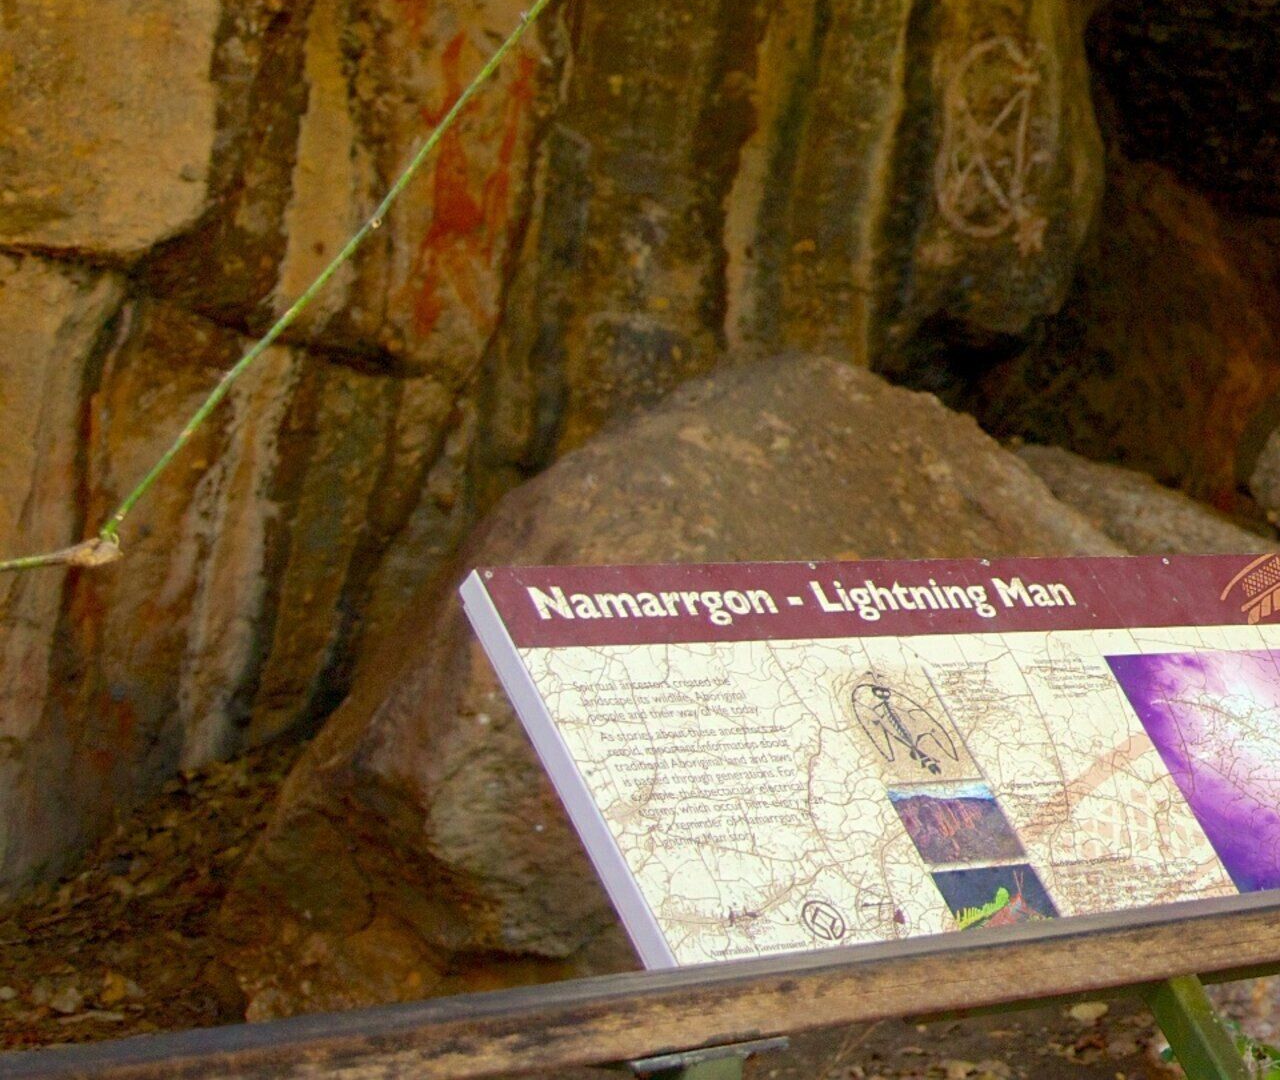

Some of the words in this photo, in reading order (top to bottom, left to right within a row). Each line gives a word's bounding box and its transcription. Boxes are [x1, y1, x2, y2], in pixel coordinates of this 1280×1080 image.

[526, 585, 778, 626] Namarrgon
[809, 578, 997, 621] Lightning
[992, 576, 1076, 608] Man
[673, 677, 711, 688] created
[713, 676, 730, 686] the
[695, 690, 746, 703] Aboriginal
[589, 710, 624, 723] people
[627, 709, 647, 720] and
[649, 708, 674, 719] their
[678, 708, 699, 719] way
[701, 706, 712, 716] of
[600, 732, 614, 742] As
[656, 729, 687, 740] about
[688, 728, 716, 738] these
[760, 738, 790, 749] about
[671, 758, 723, 771] Aboriginal
[750, 753, 767, 763] and
[623, 778, 632, 787] is
[673, 771, 714, 785] through
[778, 767, 796, 777] For
[679, 788, 696, 799] the
[759, 781, 805, 793] electrical
[679, 803, 710, 814] which
[713, 803, 741, 813] occur
[675, 818, 723, 831] reminder
[726, 817, 738, 828] of
[704, 833, 727, 845] Man
